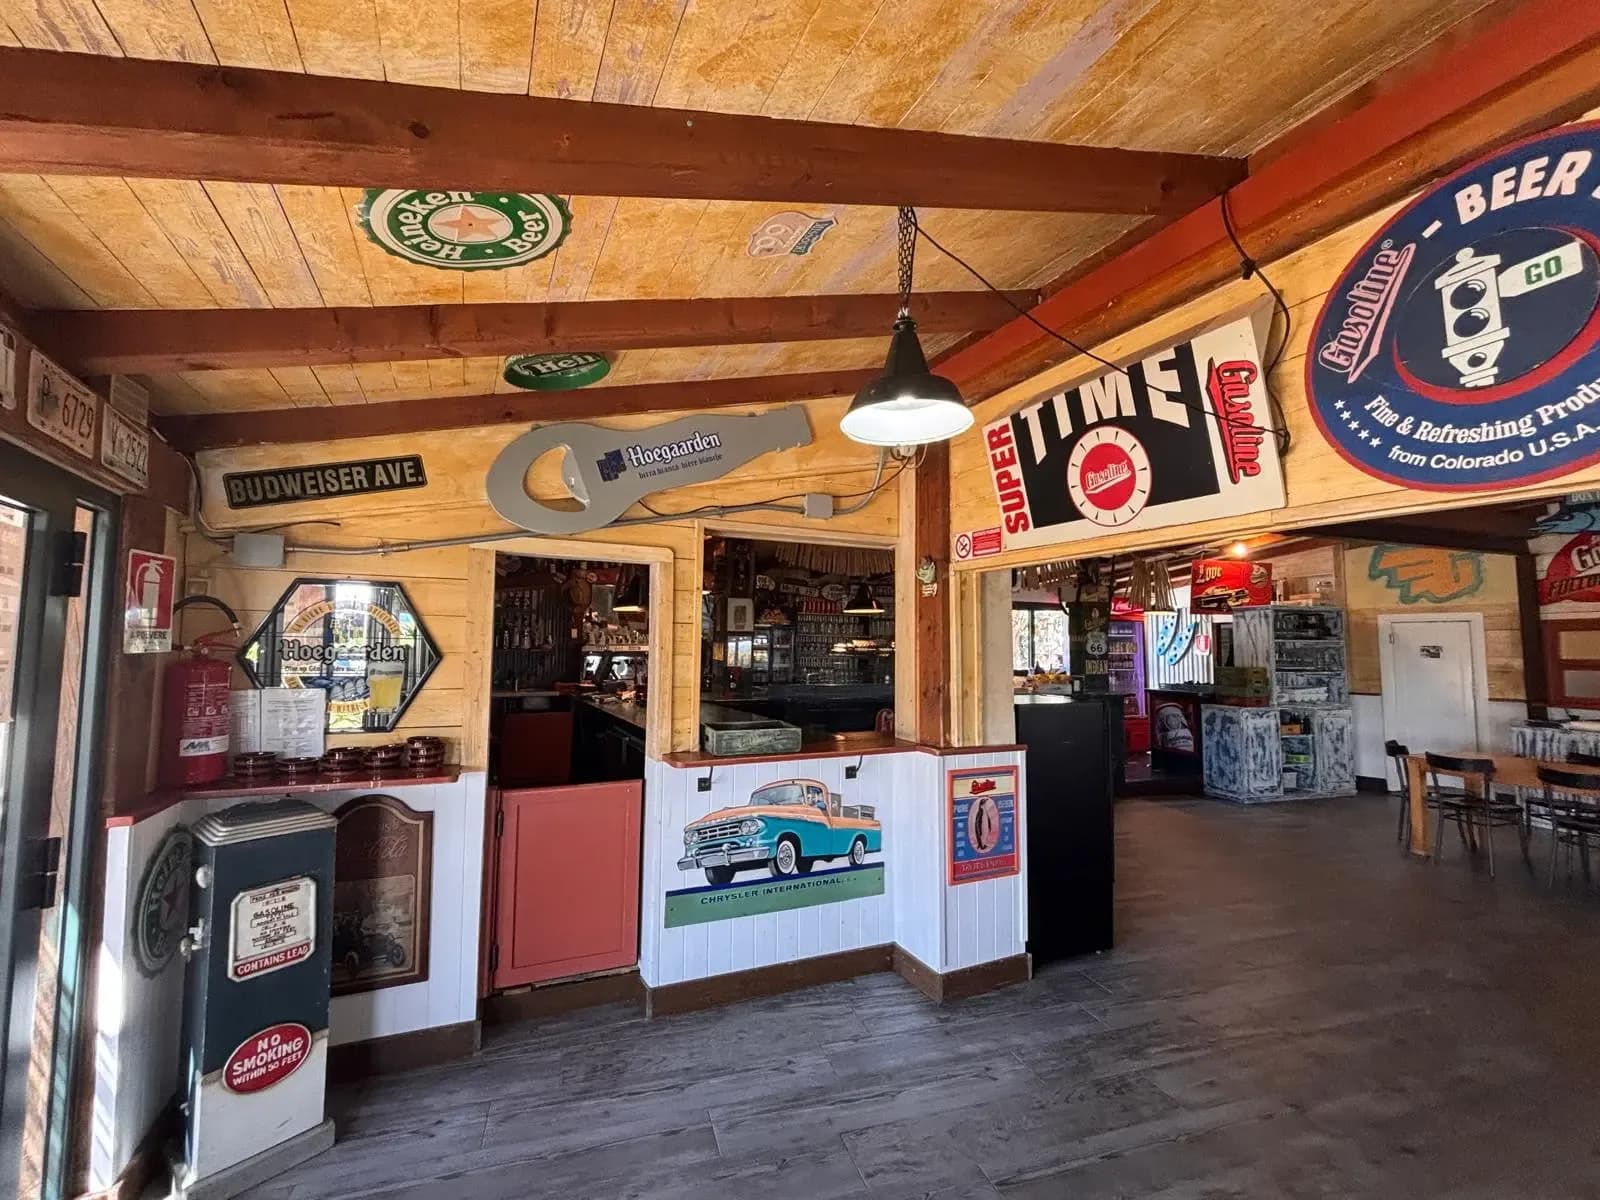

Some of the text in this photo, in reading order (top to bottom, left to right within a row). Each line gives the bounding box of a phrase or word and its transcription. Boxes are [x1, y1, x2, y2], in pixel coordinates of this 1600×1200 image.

[1455, 150, 1593, 225] BEER
[502, 210, 546, 254] Beer
[1523, 254, 1562, 287] GO
[1318, 247, 1400, 374] Gasoline
[1019, 347, 1191, 466] TIME
[1217, 359, 1263, 478] Gasoline
[1364, 394, 1402, 429] Fine
[1399, 417, 1415, 436] &
[1420, 410, 1538, 445] Refreshing
[628, 432, 721, 467] Hoegaarden
[1388, 445, 1427, 467] from
[1430, 448, 1524, 470] Colorado
[230, 461, 424, 503] BUDWEISER AVE.
[986, 423, 1030, 536] SUPER
[1086, 460, 1130, 491] Gasoline
[281, 638, 406, 665] Hoegaarden
[1090, 643, 1104, 653] 66
[700, 889, 759, 905] CHRYSLER
[237, 943, 308, 976] CONTAINS LEAD
[232, 1036, 304, 1076] SMOKING
[257, 1033, 281, 1053] NO
[232, 1065, 267, 1086] WITHIN
[282, 1050, 304, 1067] FEET
